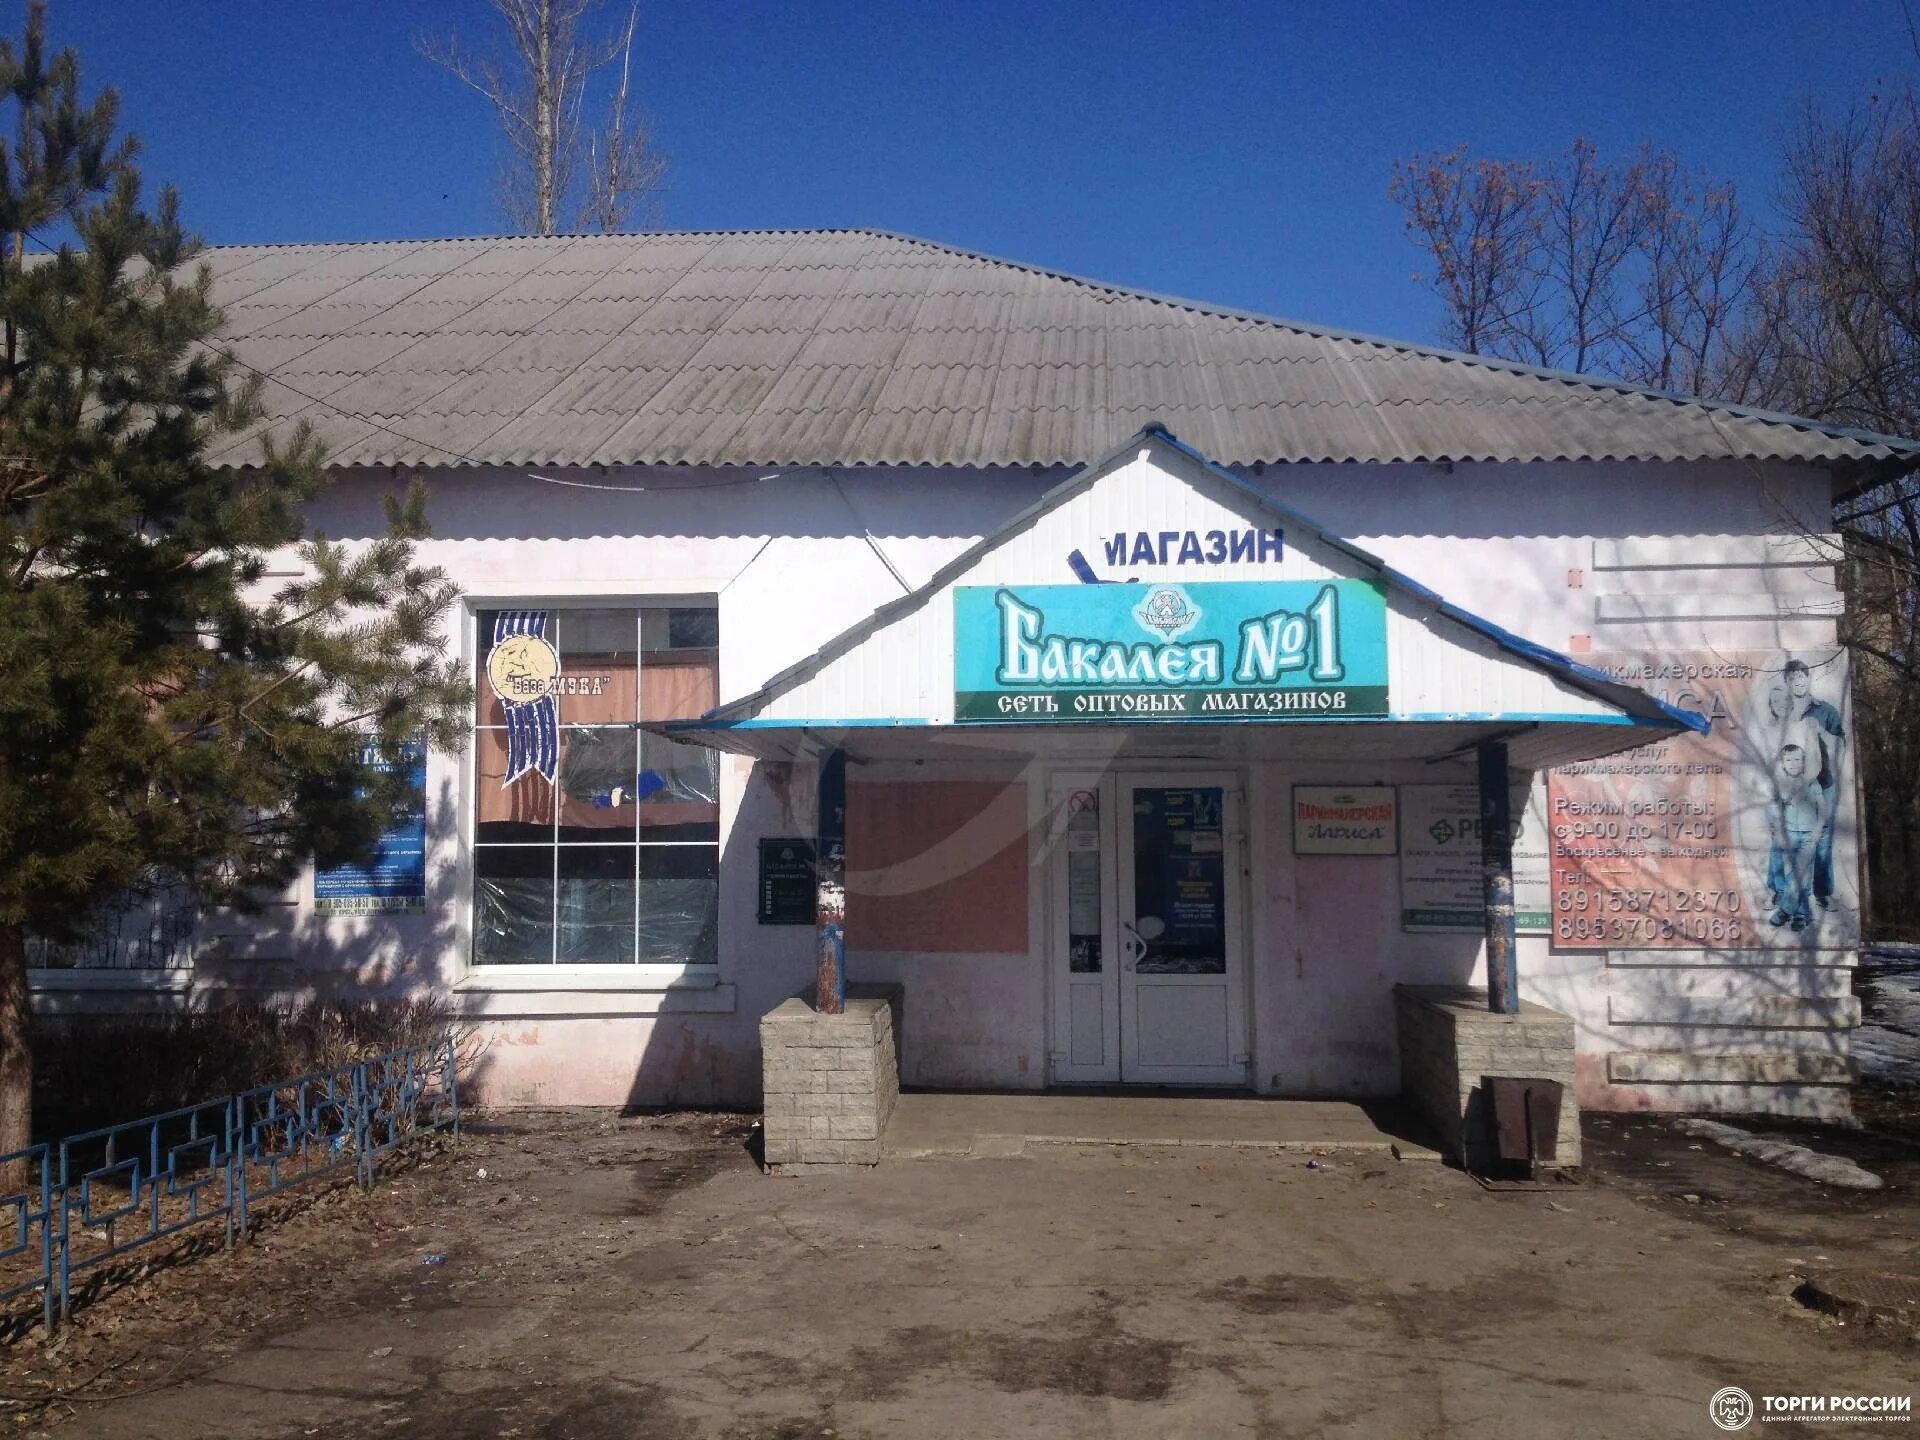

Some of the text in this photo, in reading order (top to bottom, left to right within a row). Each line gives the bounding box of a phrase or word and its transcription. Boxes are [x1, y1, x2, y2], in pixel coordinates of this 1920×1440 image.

[1105, 529, 1284, 566] МАГАЗИН
[1201, 690, 1346, 712] МАГАЗИНОВ
[1555, 798, 1715, 820] Режим работы:
[1574, 822, 1619, 838] 9-00
[1626, 823, 1652, 842] до
[1661, 822, 1718, 839] 17-00
[1556, 844, 1645, 858] Воскресенье
[1661, 844, 1729, 858] выходной
